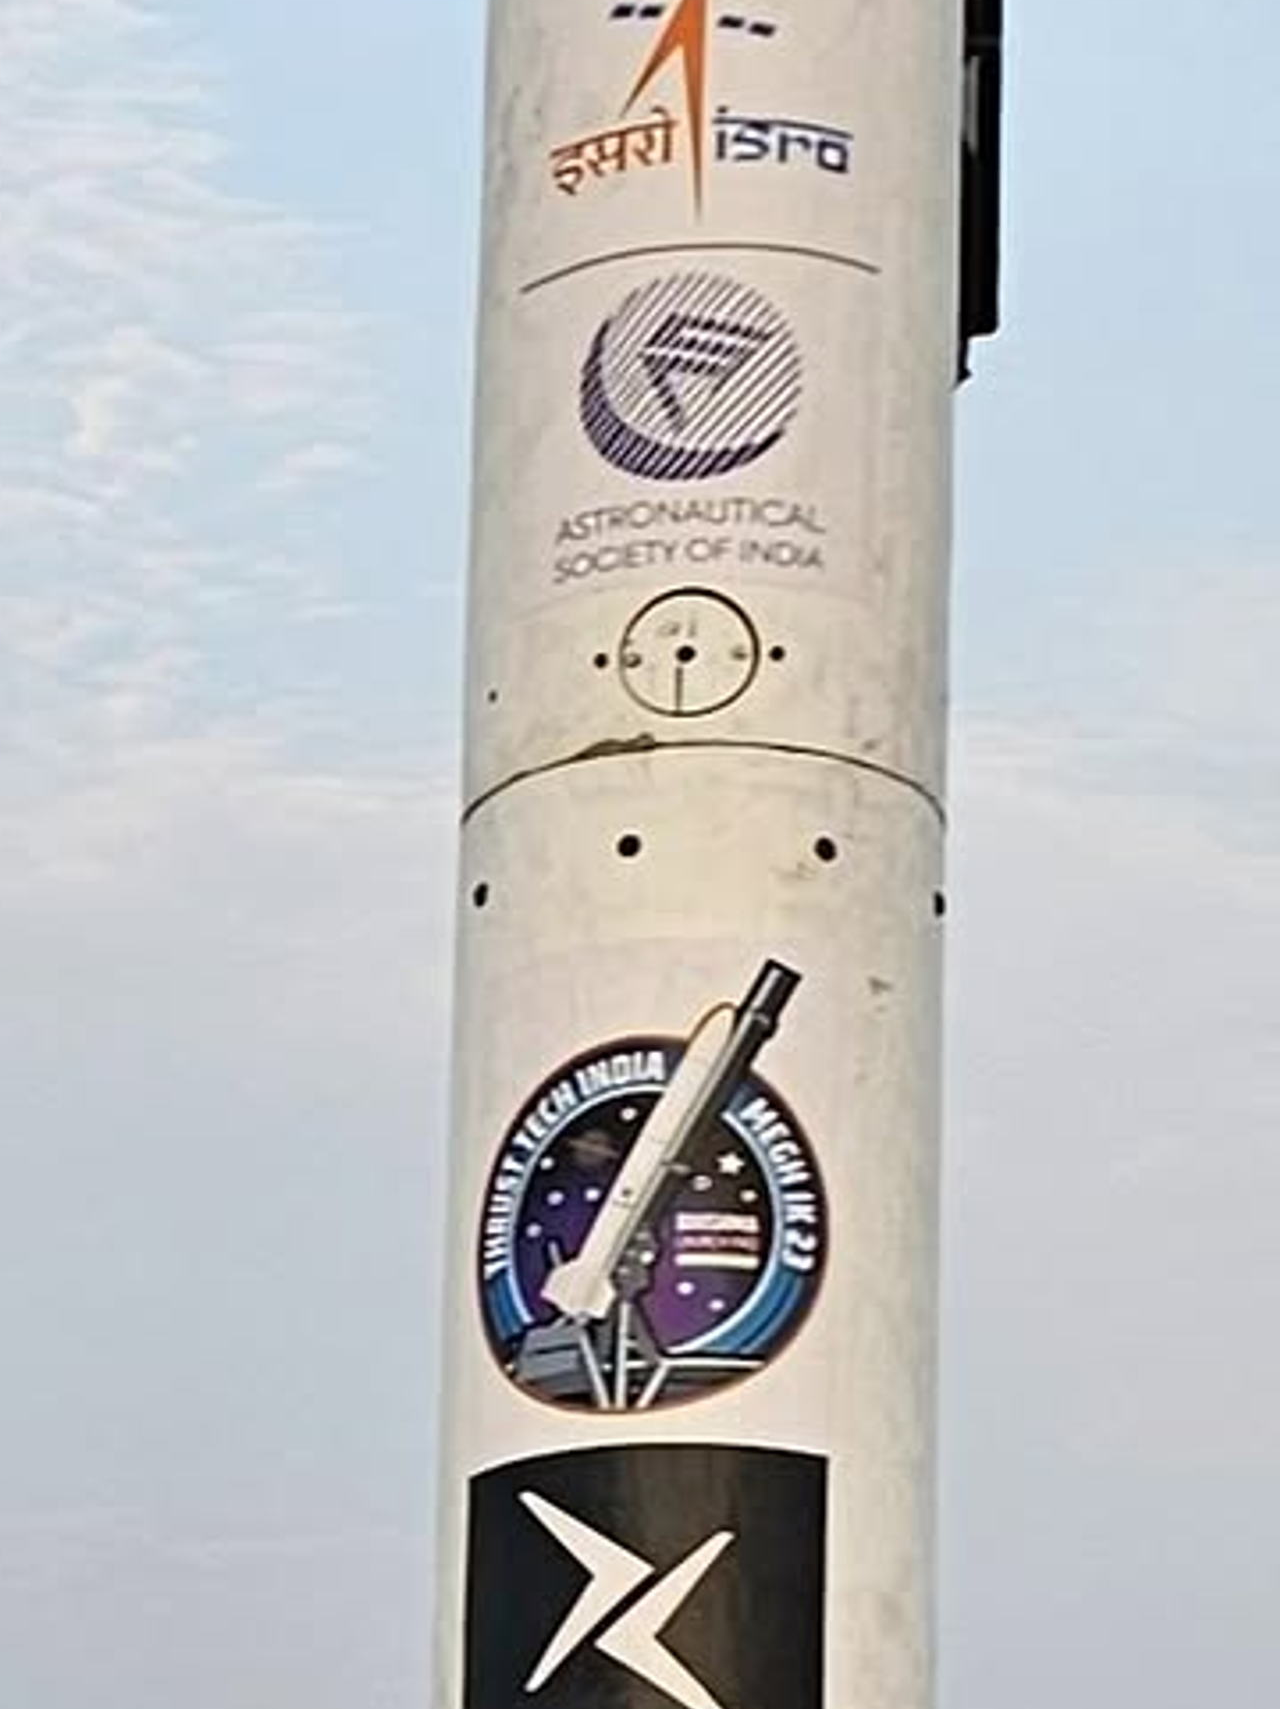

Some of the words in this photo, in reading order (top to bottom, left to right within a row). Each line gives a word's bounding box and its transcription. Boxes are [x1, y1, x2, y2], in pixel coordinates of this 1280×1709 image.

[550, 105, 679, 195] इसरो
[552, 539, 679, 583] SOCIETY
[685, 537, 732, 563] OF
[740, 539, 824, 572] INDIA
[555, 496, 827, 544] ASTRONAUTICAL
[512, 1080, 578, 1151] TECH
[575, 1050, 666, 1096] INDIA
[738, 1097, 812, 1185] MEGH
